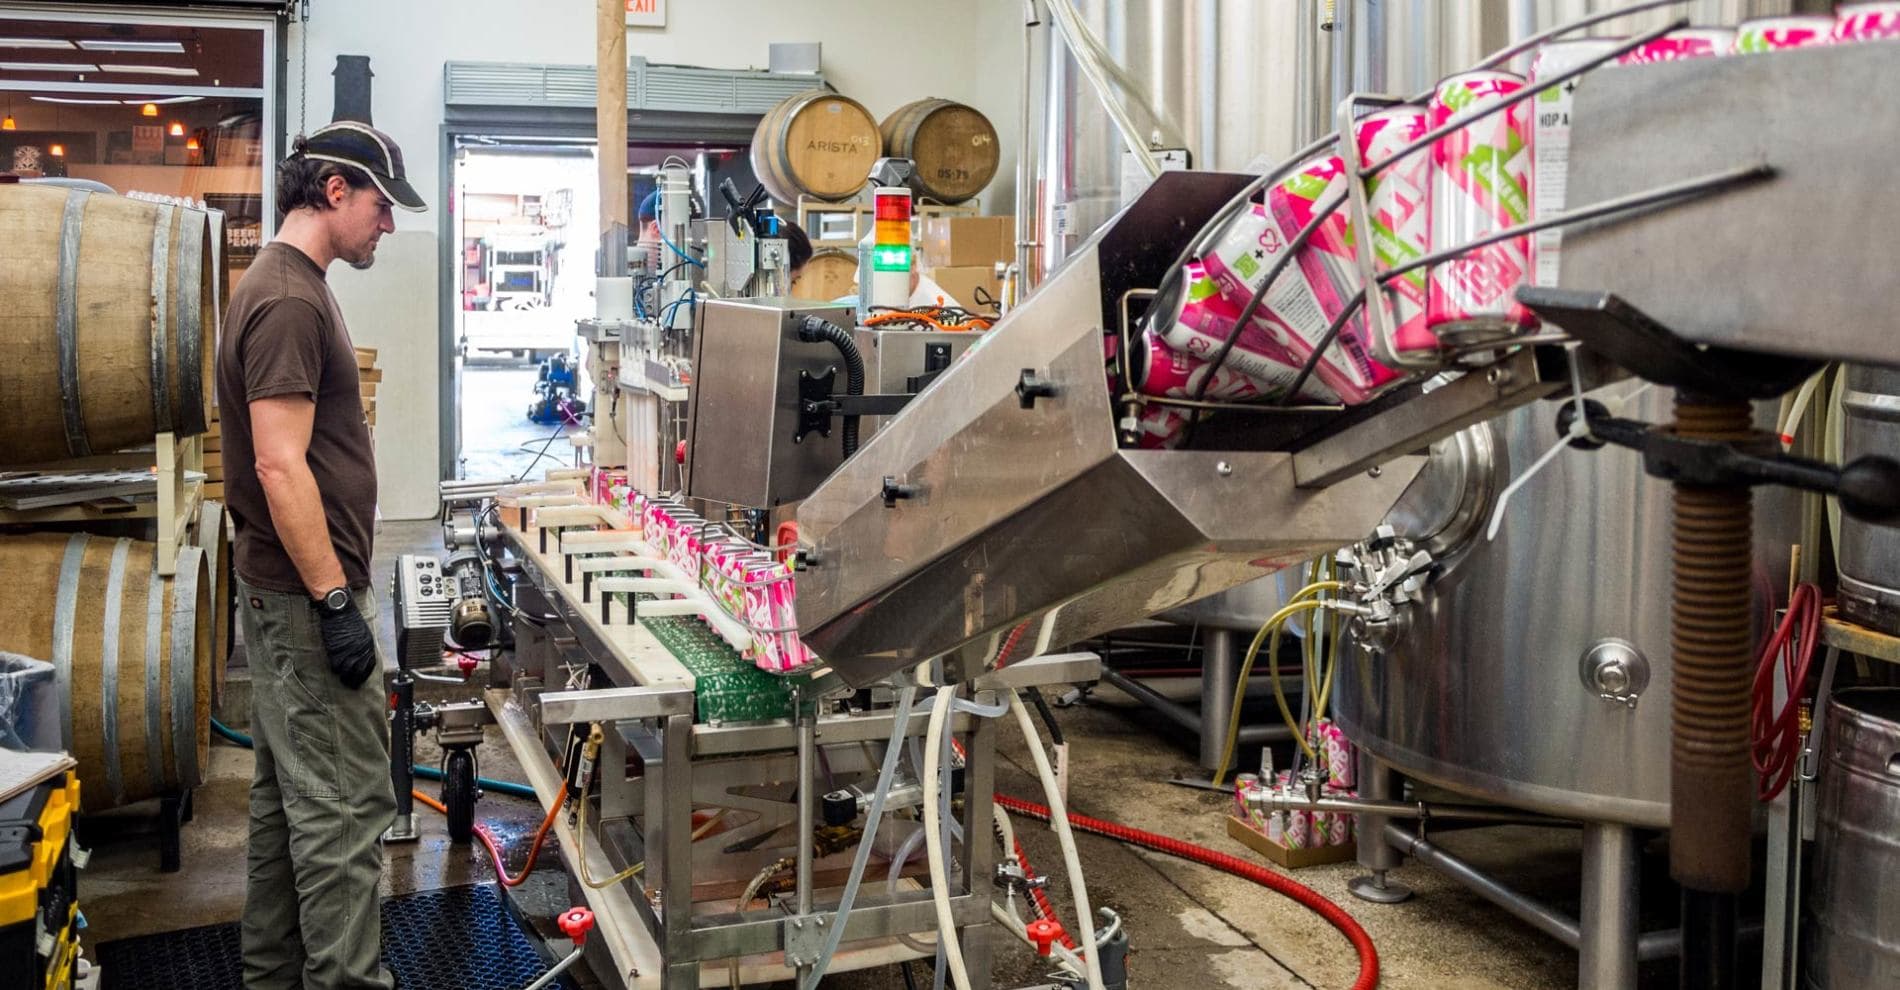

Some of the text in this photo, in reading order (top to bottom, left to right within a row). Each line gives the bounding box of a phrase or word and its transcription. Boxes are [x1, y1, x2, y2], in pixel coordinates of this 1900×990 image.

[807, 140, 858, 154] ARISTA
[972, 133, 992, 147] 014
[226, 228, 256, 238] BEER
